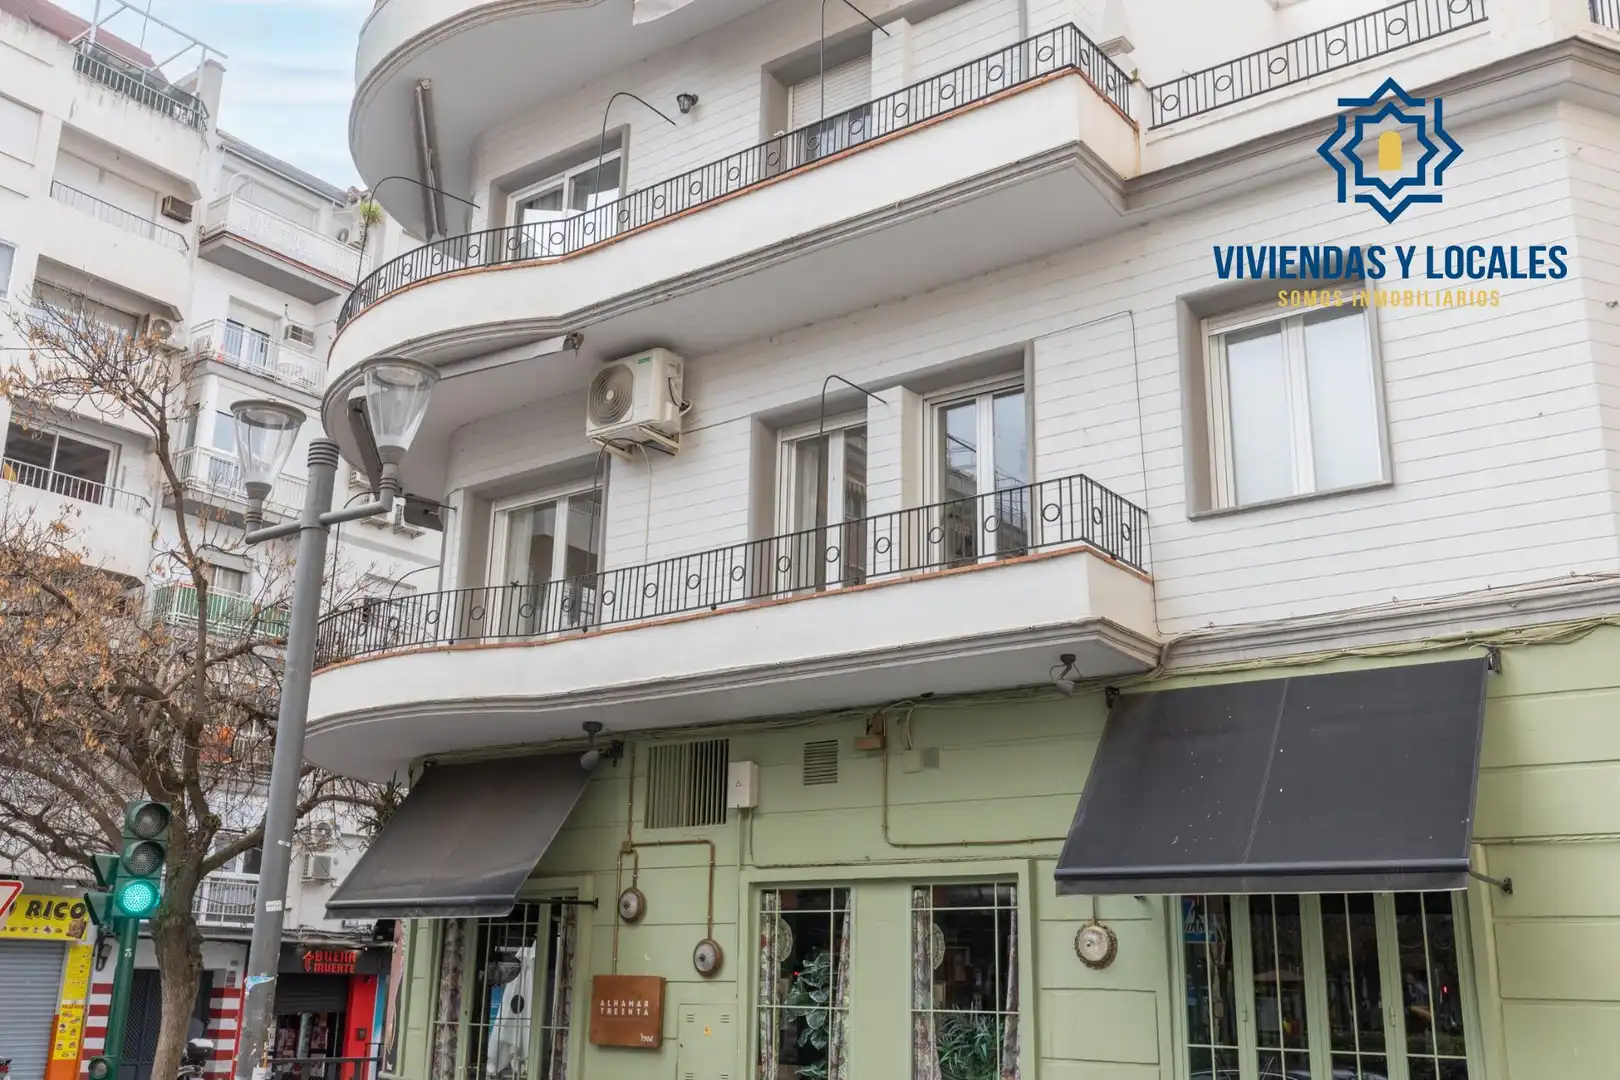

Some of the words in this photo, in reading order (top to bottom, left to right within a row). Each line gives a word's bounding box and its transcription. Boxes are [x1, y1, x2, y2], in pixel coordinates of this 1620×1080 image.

[25, 900, 86, 920] RICO
[314, 963, 355, 973] MUERTE
[600, 1008, 649, 1016] TREINTA
